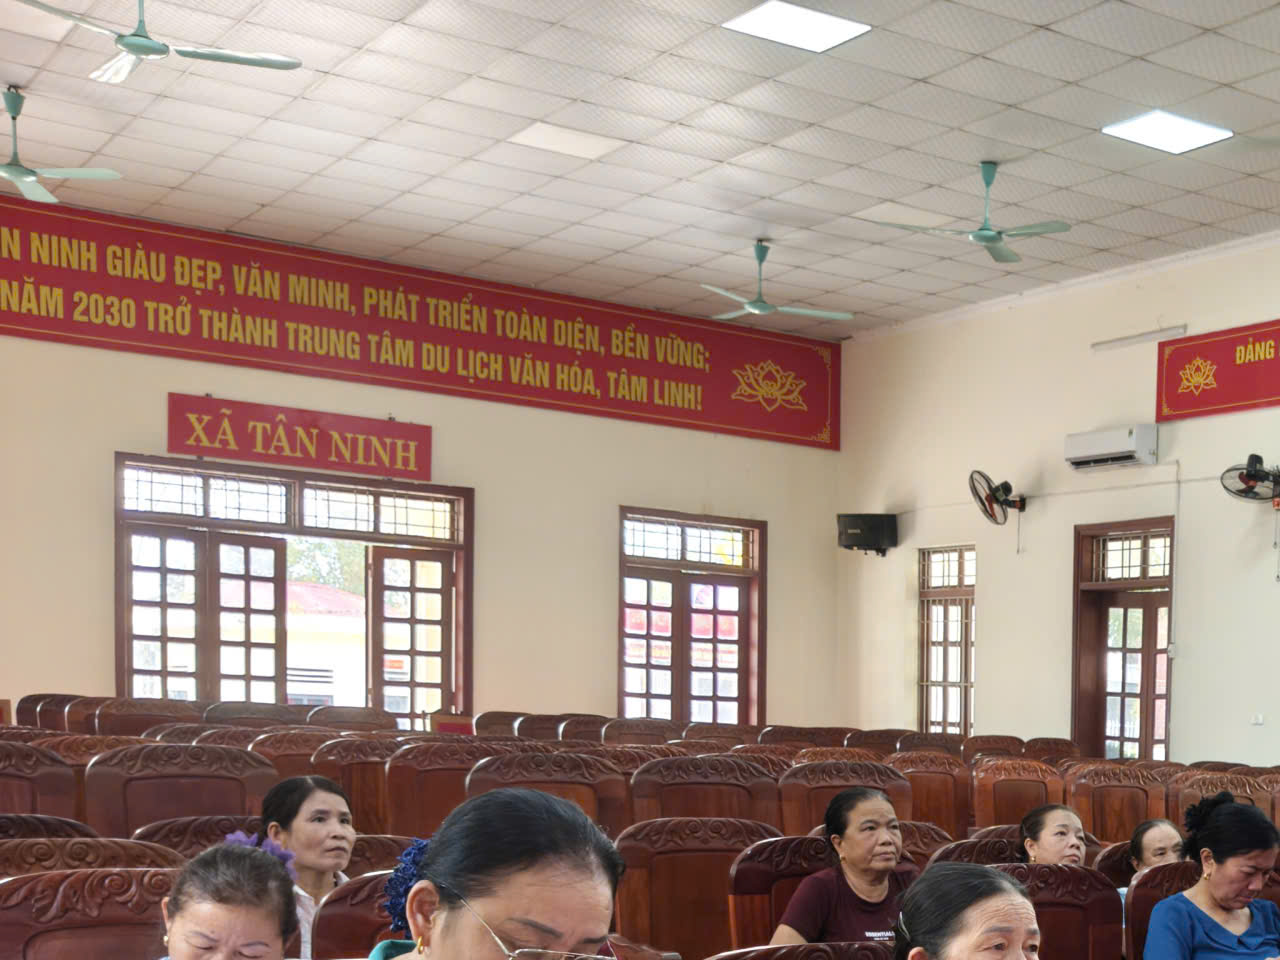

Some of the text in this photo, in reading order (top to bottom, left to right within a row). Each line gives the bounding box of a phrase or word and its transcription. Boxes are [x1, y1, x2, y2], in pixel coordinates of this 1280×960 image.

[0, 274, 704, 411] NĂM 2030 TRỞ THÀNH TRUNG TÂM DU LỊCH VĂN HÓA, TÂM LINH!
[30, 231, 97, 273] NINH
[106, 241, 166, 283] GIÀU
[173, 256, 225, 297] ĐẸP,
[232, 261, 281, 303] VĂN
[288, 275, 356, 317] MINH,
[363, 286, 418, 324] PHÁT
[427, 293, 488, 335] TRIỂN
[493, 308, 548, 344] TOÀN
[552, 316, 604, 357] DIỆN,
[611, 322, 650, 361] BỀN
[655, 332, 711, 373] VỮNG;
[1235, 337, 1275, 364] ĐẢNG
[185, 408, 419, 472] XÃ TÂN NINH
